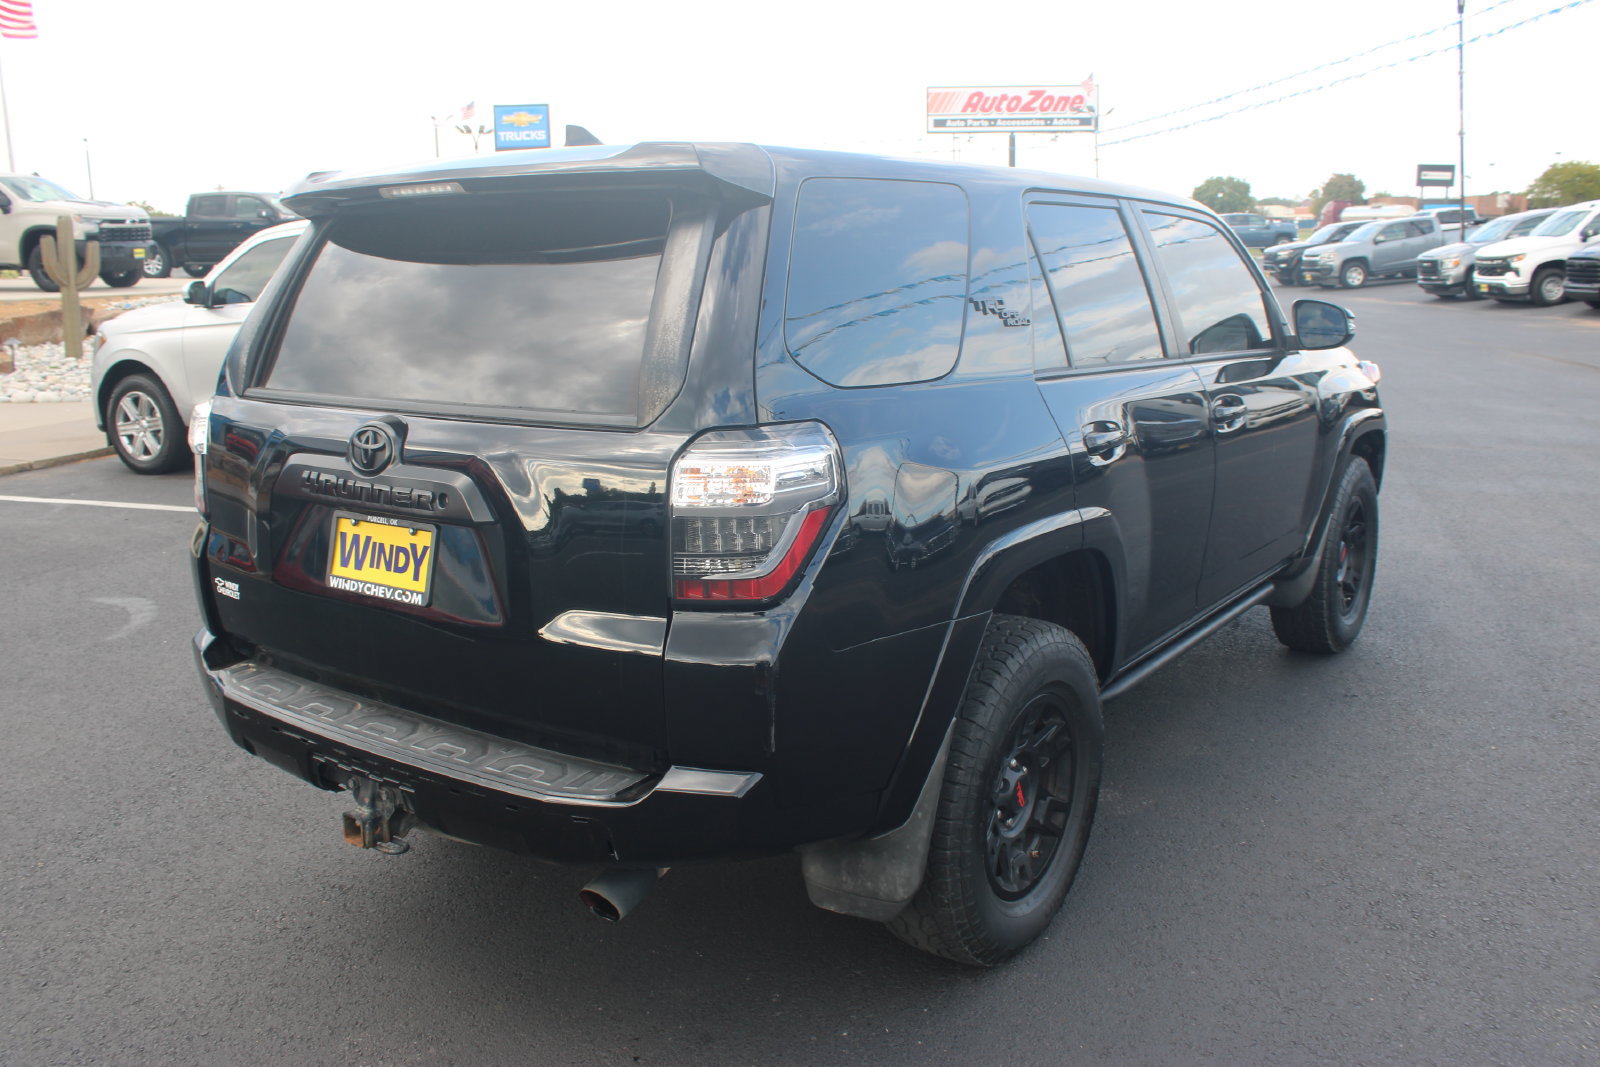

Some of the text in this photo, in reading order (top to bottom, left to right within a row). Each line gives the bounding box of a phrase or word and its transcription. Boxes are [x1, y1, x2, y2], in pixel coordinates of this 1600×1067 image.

[961, 89, 1085, 113] AutoZone
[945, 119, 967, 127] Auto
[996, 118, 1046, 127] Accessories
[1052, 118, 1081, 126] Advice
[497, 129, 547, 141] TRUCKS
[339, 531, 431, 582] WINDY
[329, 575, 423, 606] WINDYCHEV.COM
